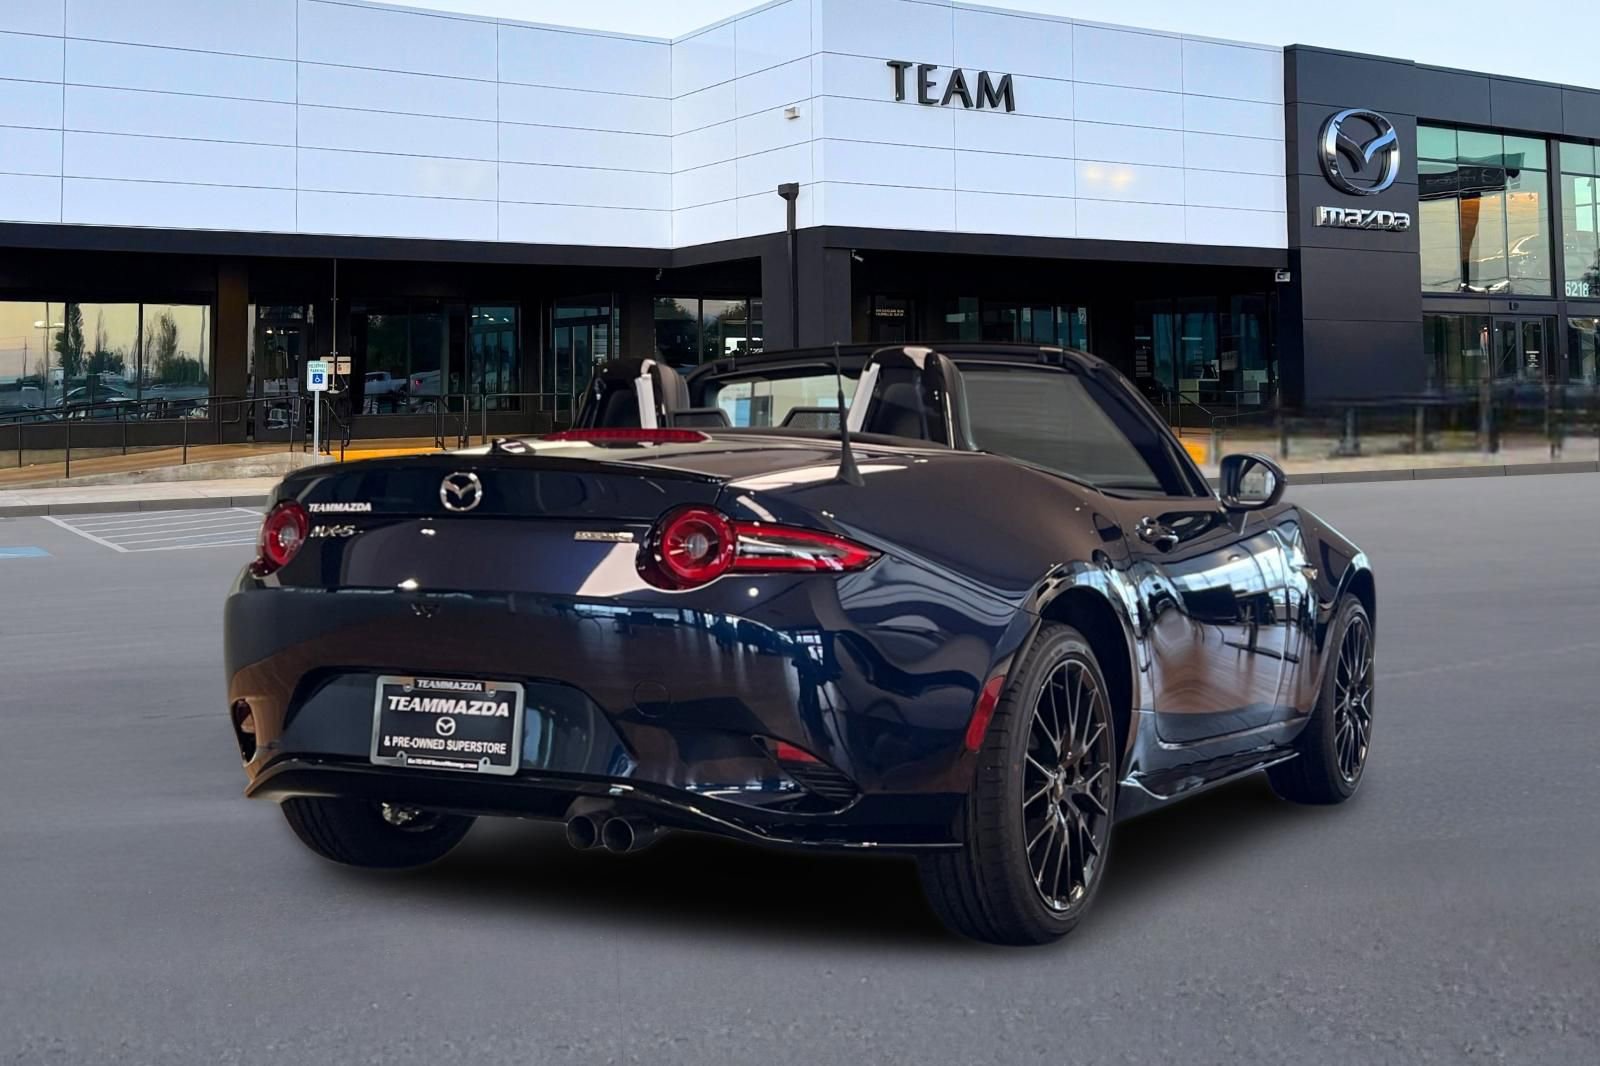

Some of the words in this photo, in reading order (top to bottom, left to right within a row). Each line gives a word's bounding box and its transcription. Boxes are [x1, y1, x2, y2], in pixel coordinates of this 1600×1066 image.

[886, 60, 1015, 112] TEAM
[1314, 206, 1411, 232] mazda
[1565, 281, 1590, 297] 6218
[308, 502, 371, 512] TEAMMAZDA
[416, 679, 482, 691] TEAMMAZDA
[387, 696, 509, 717] TEAMMAZDA
[384, 735, 391, 746] &
[392, 736, 445, 750] PRE-OWNED
[446, 740, 507, 754] SUPERSTORE
